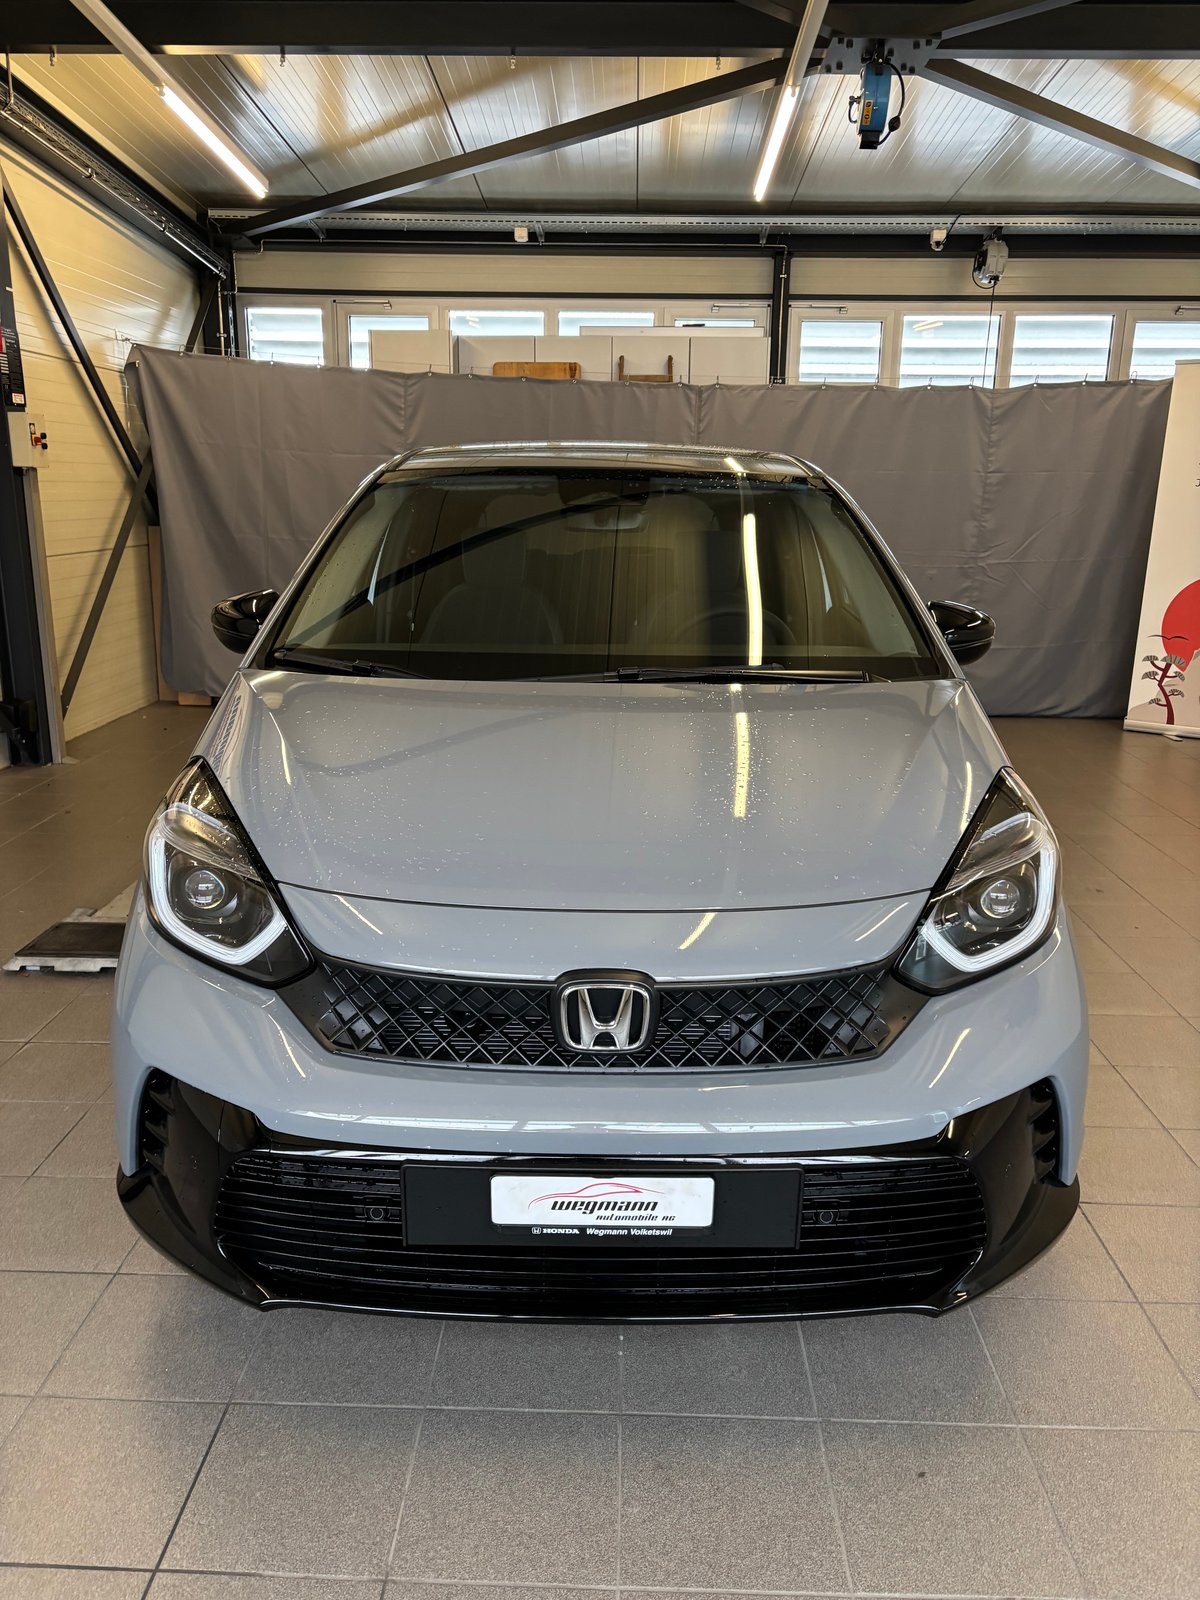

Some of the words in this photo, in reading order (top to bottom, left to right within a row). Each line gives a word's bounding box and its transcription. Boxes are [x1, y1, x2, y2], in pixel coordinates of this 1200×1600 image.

[551, 1200, 658, 1215] wegmann
[596, 1213, 659, 1221] automobile
[586, 1227, 628, 1236] Wegmann
[630, 1228, 673, 1236] Volketswil
